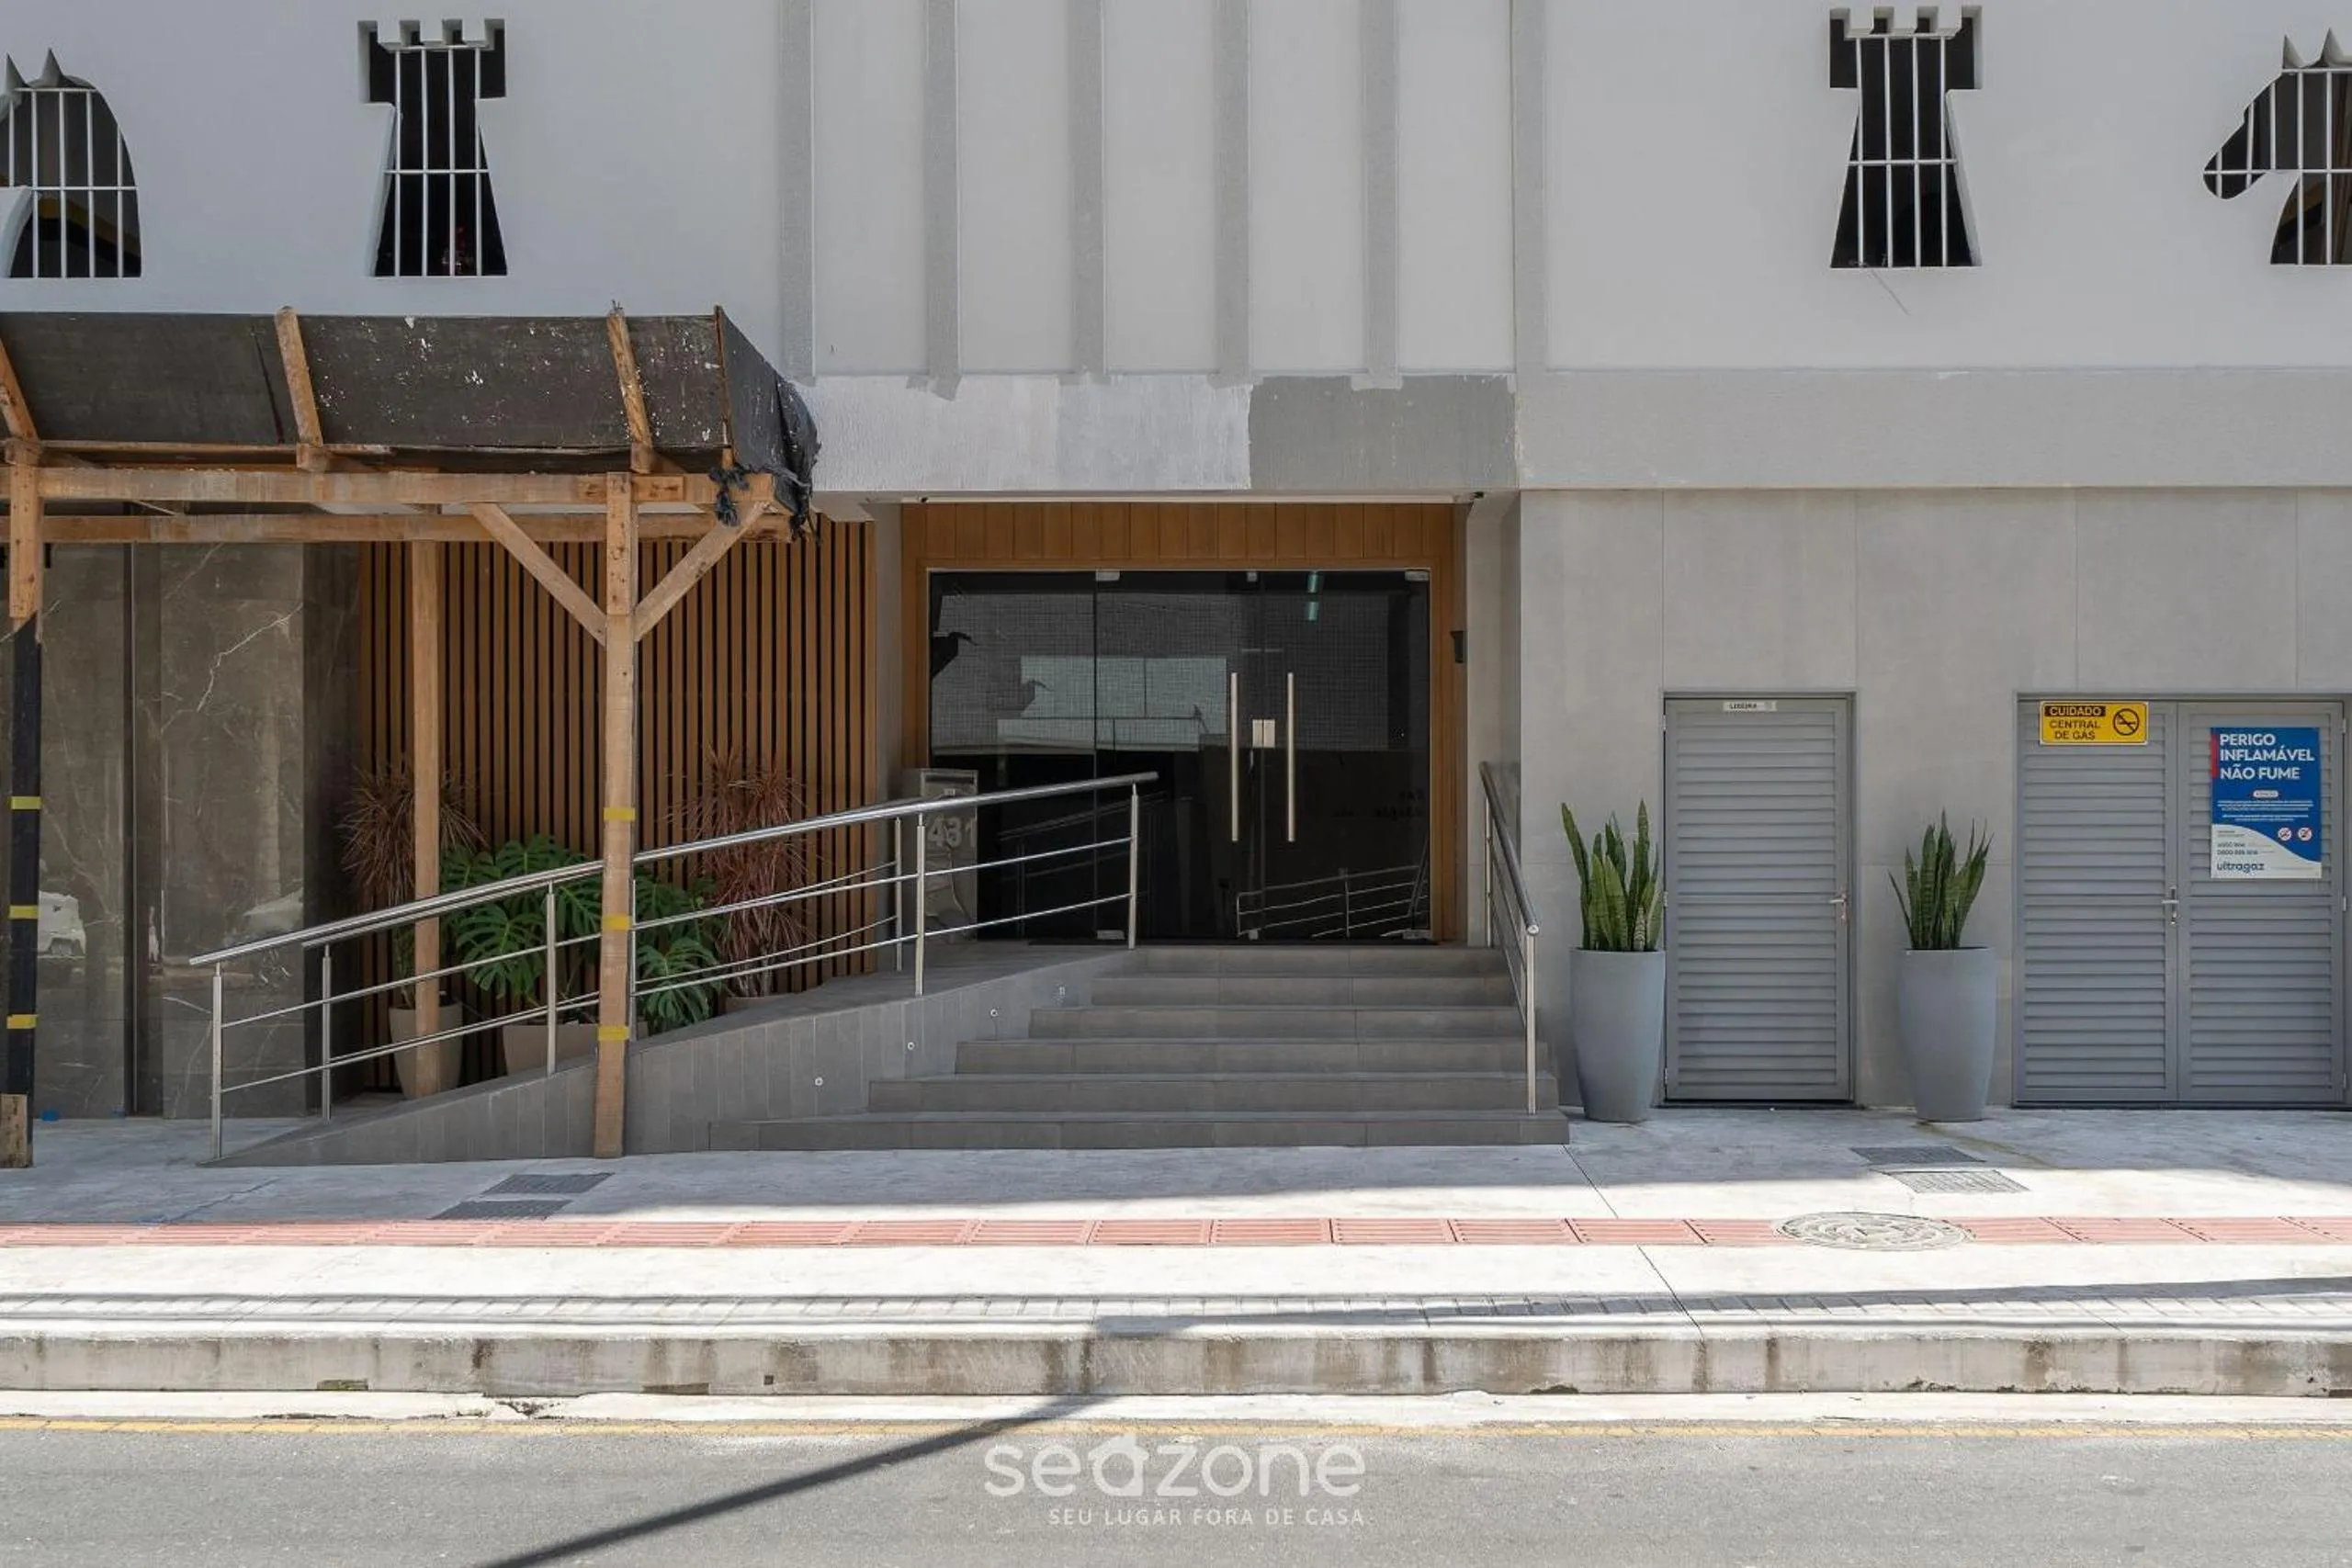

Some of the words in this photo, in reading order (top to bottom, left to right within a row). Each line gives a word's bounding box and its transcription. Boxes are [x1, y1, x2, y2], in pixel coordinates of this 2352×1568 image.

[2050, 706, 2102, 716] CUIDADO
[2050, 719, 2101, 728] CENTRAL
[2054, 730, 2069, 739] DE
[2220, 734, 2276, 746] PERIGO
[2220, 745, 2315, 761] INFLAMÁVEL
[2220, 763, 2255, 780] NÃO
[2258, 767, 2301, 780] FUME
[2217, 861, 2265, 873] ultragaz
